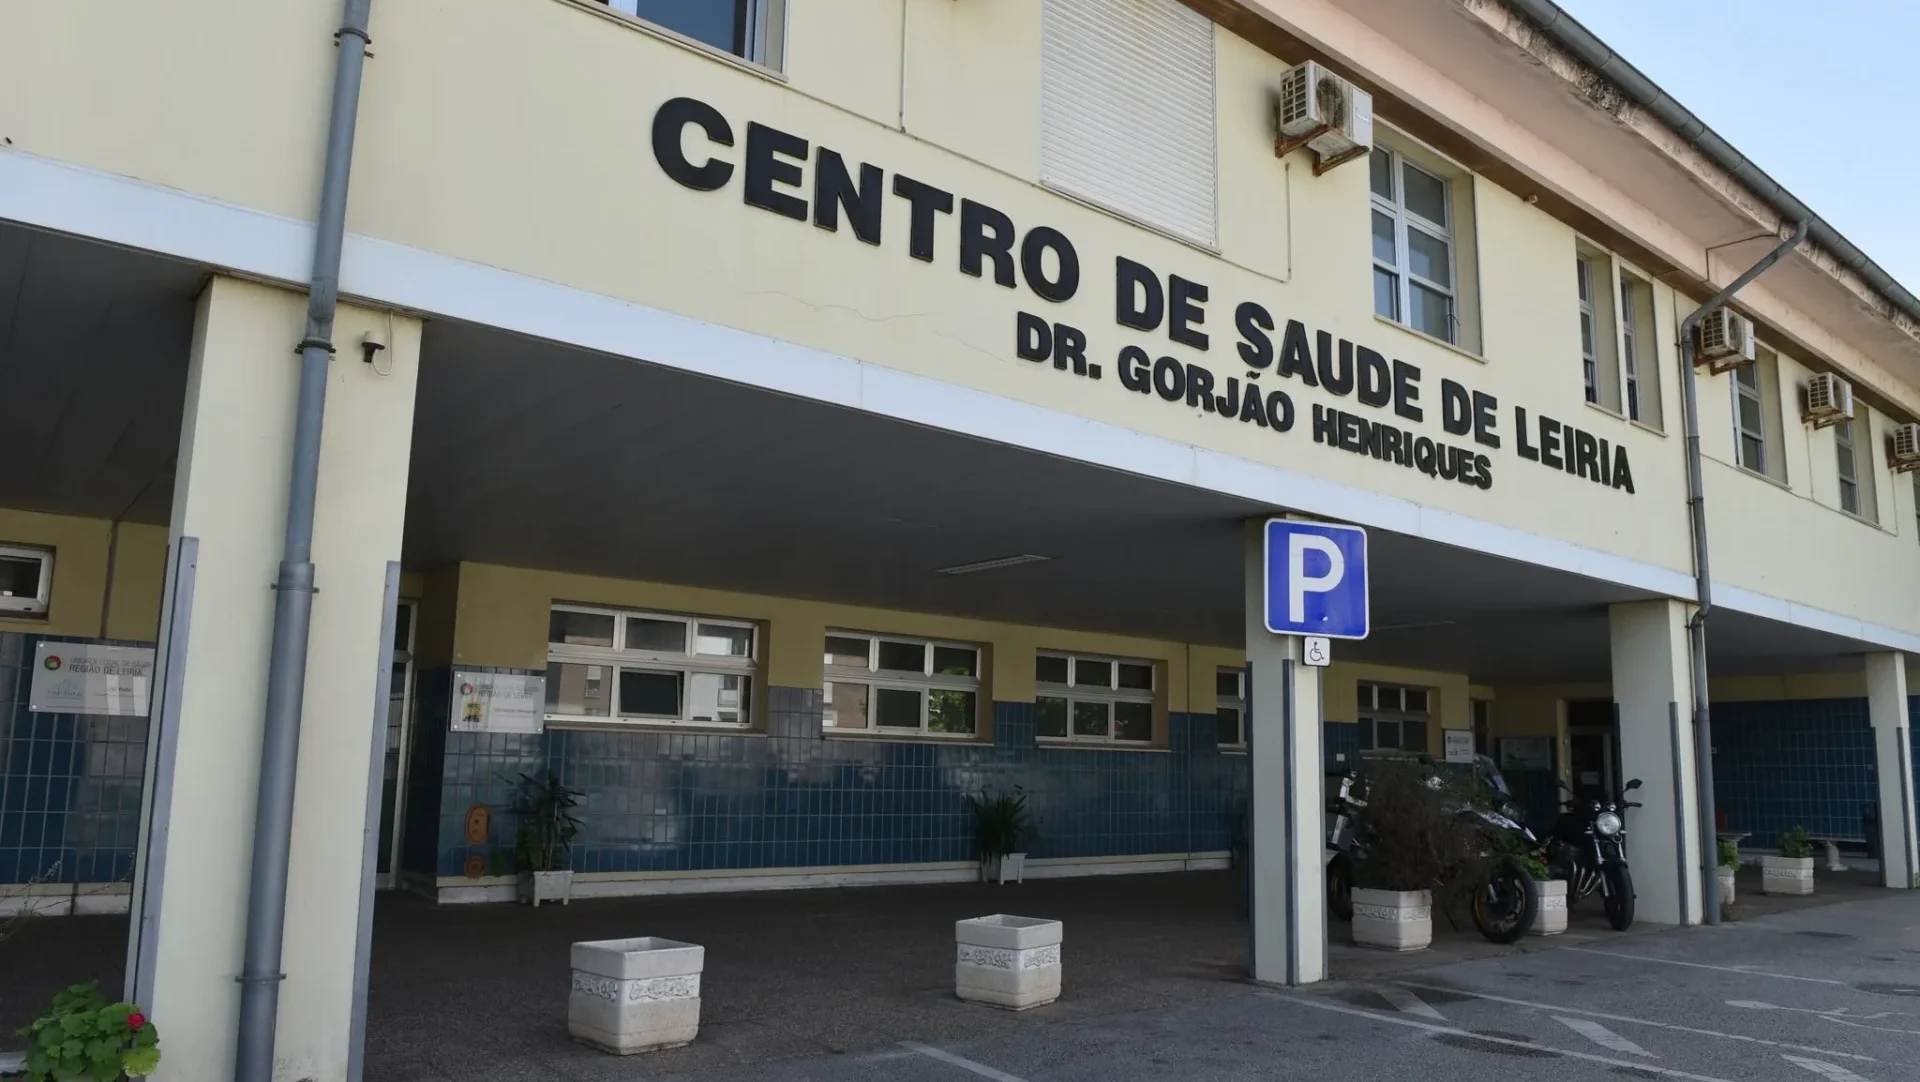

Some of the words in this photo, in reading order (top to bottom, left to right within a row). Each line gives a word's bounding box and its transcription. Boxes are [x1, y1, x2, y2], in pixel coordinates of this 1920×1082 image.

[651, 96, 1080, 304] CENTRO
[1115, 255, 1210, 352] DE
[1234, 301, 1424, 423] SAUDE
[1441, 378, 1501, 450] DE
[1514, 405, 1636, 495] LEIRIA
[1016, 310, 1102, 380] DR.
[1117, 345, 1295, 433] GORJÃO
[1312, 403, 1493, 491] HENRIQUES
[1289, 532, 1345, 623] P
